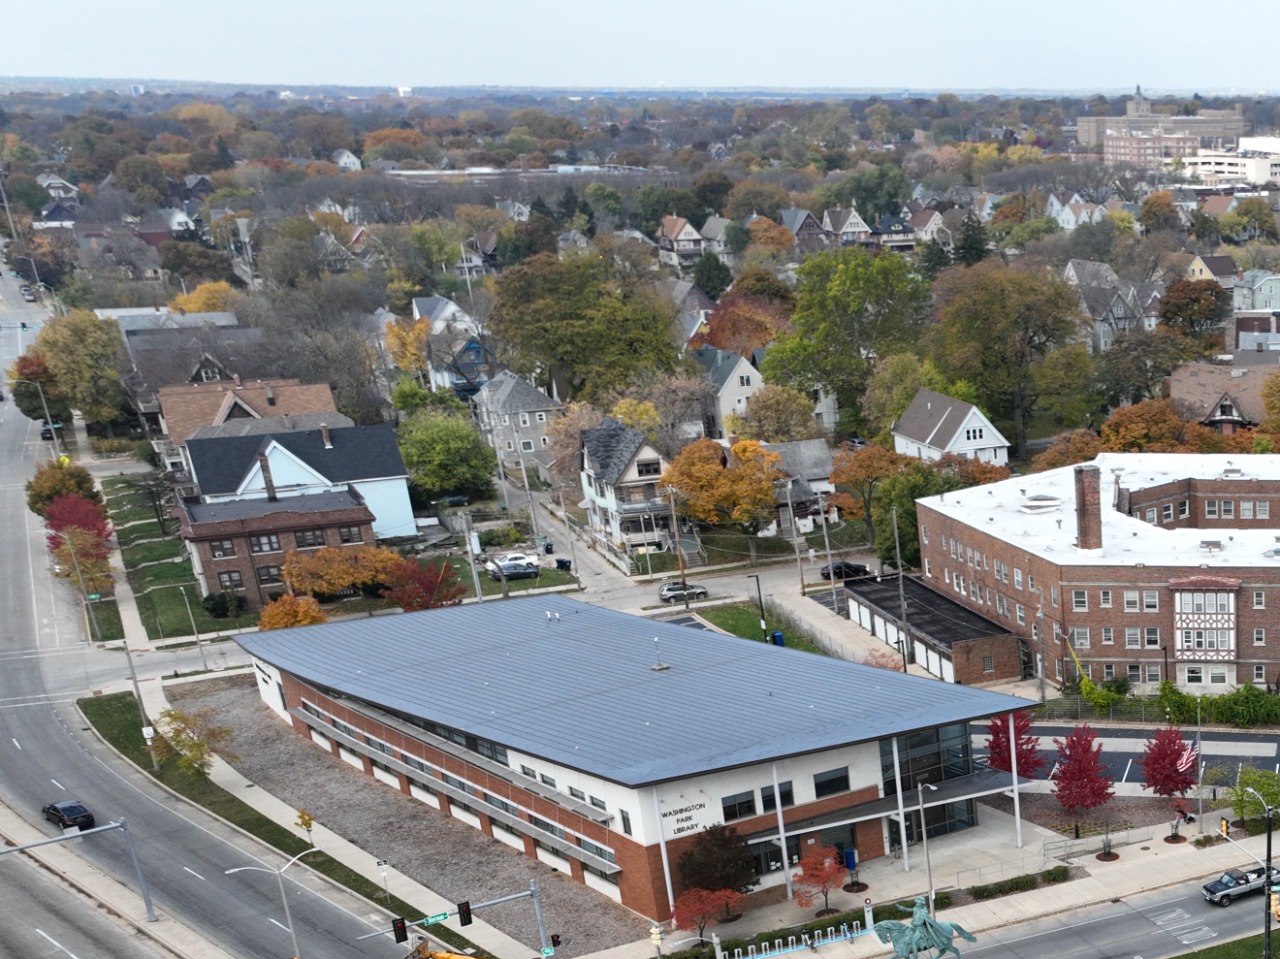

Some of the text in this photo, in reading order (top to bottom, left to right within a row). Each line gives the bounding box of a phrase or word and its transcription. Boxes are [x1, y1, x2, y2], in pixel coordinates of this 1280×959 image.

[661, 802, 706, 818] WASHINGTON
[676, 815, 693, 824] PARK
[673, 823, 699, 835] LIBRARY
